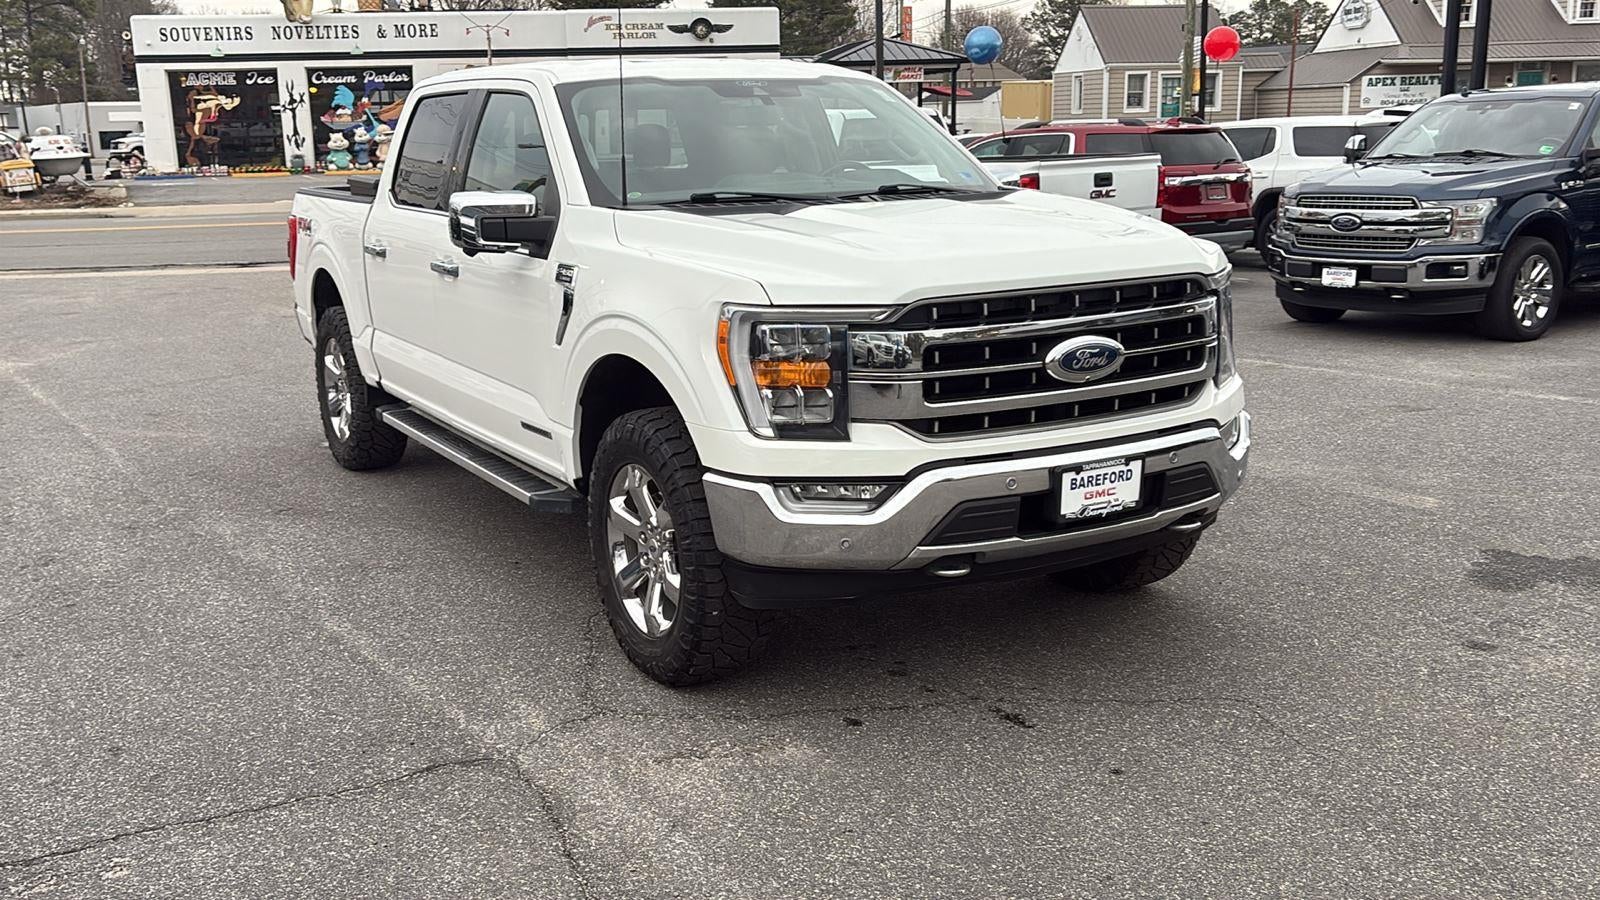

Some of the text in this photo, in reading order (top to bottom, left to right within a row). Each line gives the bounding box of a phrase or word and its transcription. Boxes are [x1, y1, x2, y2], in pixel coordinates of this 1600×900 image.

[159, 23, 438, 42] SOUVENIRS NOVELTIES & MORE
[605, 23, 664, 31] ICE CREAM
[187, 71, 275, 86] ACME Ice
[311, 70, 410, 84] Cream Parlor
[1367, 75, 1442, 87] APEX REALTY
[1090, 189, 1116, 199] GMC
[1072, 348, 1109, 369] Ford
[1082, 458, 1126, 471] TAPPAHANNOCK
[1070, 468, 1133, 491] BAREFORD
[1084, 487, 1117, 500] GMC
